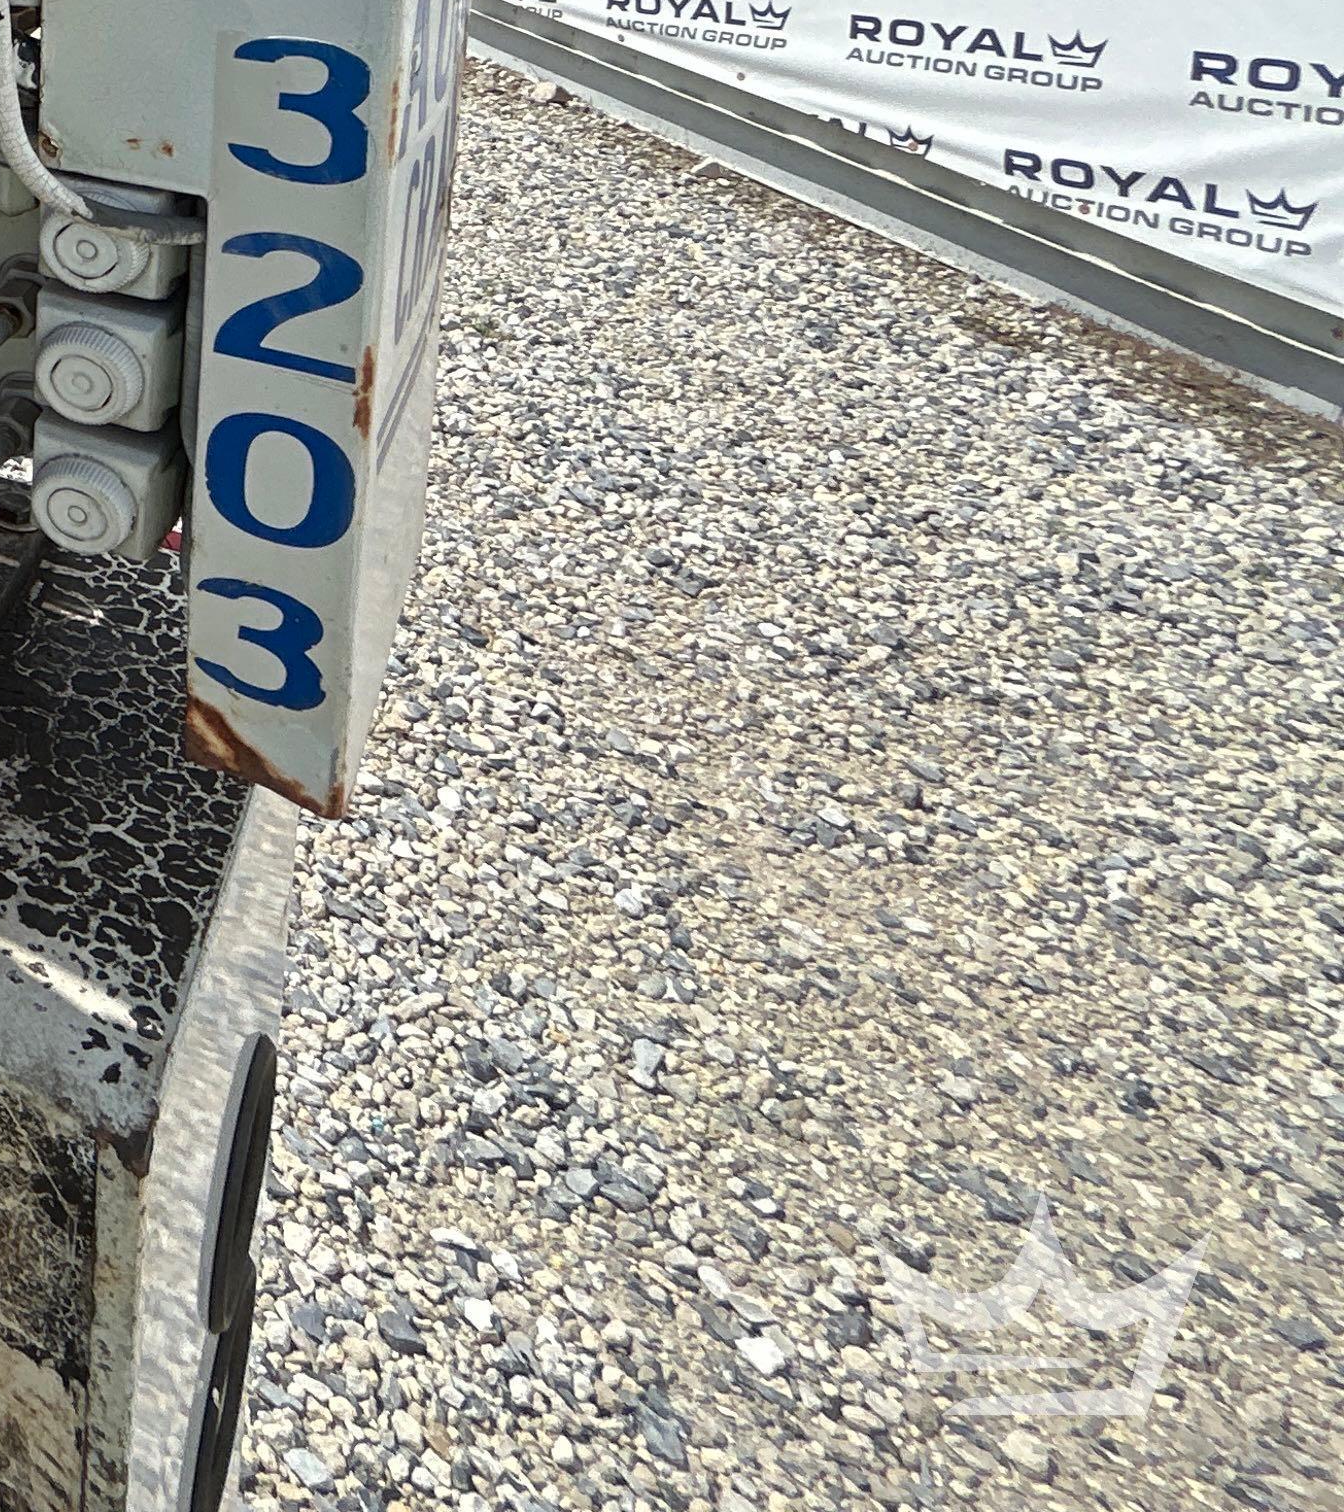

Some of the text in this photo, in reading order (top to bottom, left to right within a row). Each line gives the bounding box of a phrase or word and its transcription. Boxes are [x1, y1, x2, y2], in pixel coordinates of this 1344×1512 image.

[606, 16, 788, 51] AUCTION GROUP
[849, 14, 1044, 62] ROYAL
[846, 46, 1104, 93] AUCTION GROUP
[1190, 50, 1344, 99] ROY
[1189, 90, 1344, 127] AUCTIO
[1003, 148, 1240, 219] ROYAL
[1169, 217, 1313, 258] GROUP
